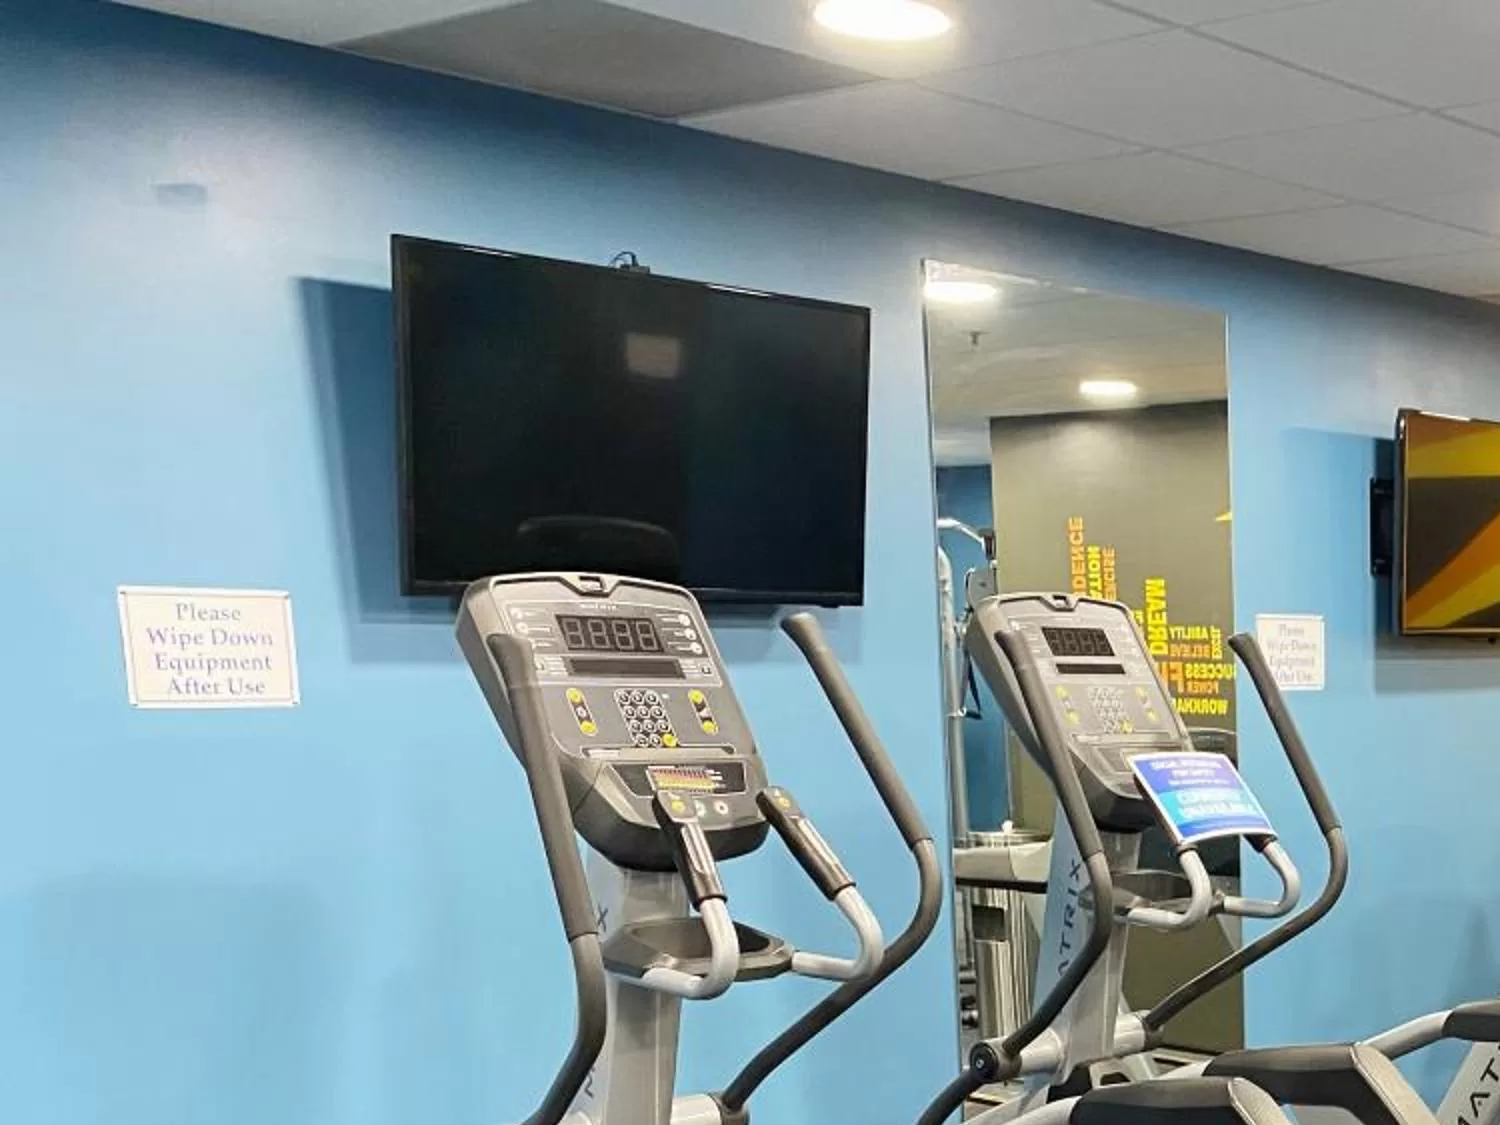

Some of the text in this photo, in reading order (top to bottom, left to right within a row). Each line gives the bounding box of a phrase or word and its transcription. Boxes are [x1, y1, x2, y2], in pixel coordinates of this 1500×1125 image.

[176, 603, 241, 621] Please
[146, 627, 273, 650] Wipe Down
[155, 653, 272, 676] Equipment
[168, 678, 266, 695] After Use
[1057, 859, 1081, 977] ATRIX
